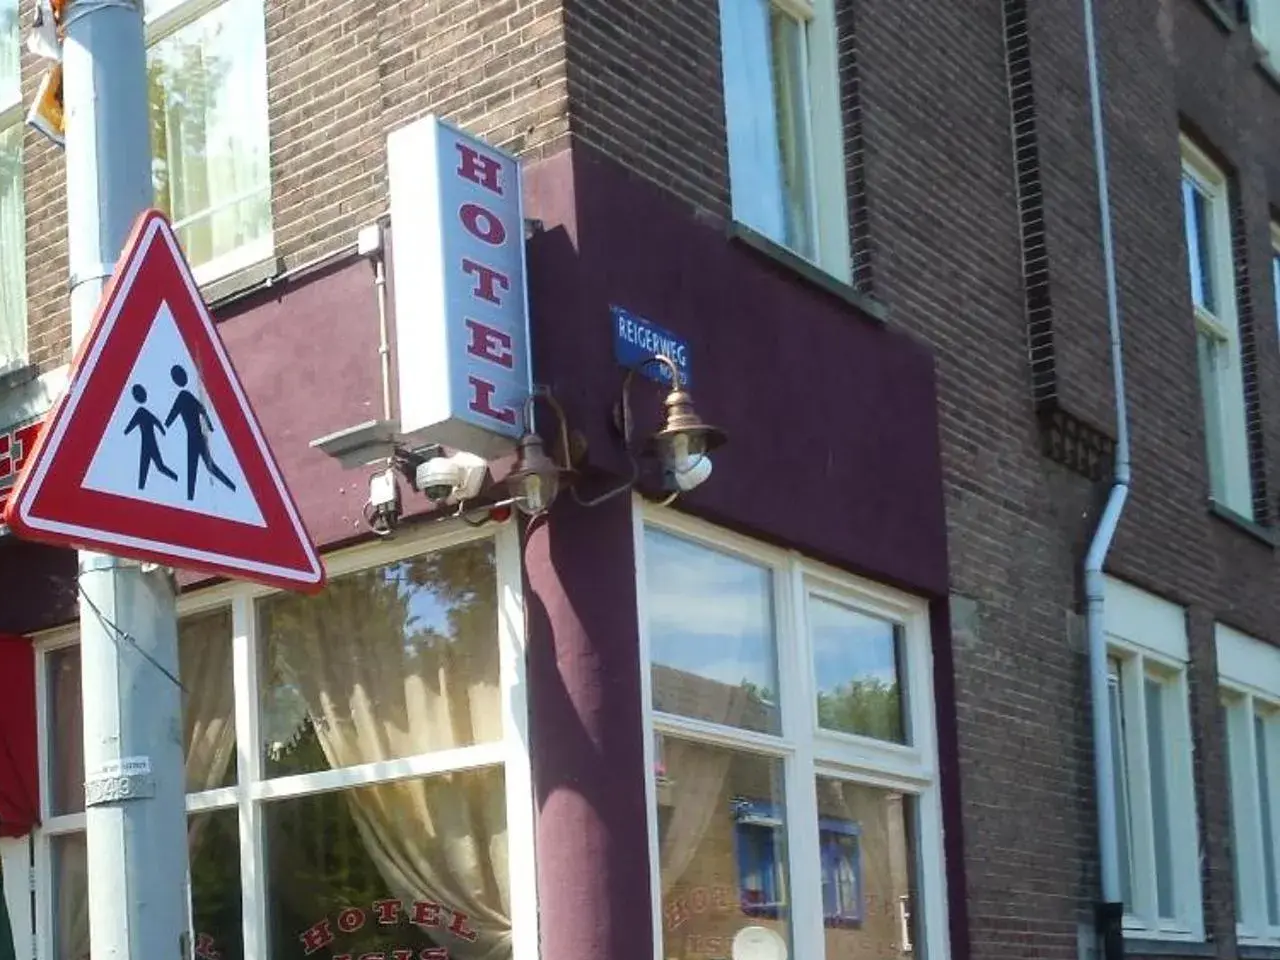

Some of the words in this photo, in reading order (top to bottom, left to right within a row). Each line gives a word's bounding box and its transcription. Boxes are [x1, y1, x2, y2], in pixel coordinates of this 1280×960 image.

[454, 140, 516, 426] HOTEL
[619, 316, 687, 367] REIGERWEG
[300, 898, 478, 955] HOTEL
